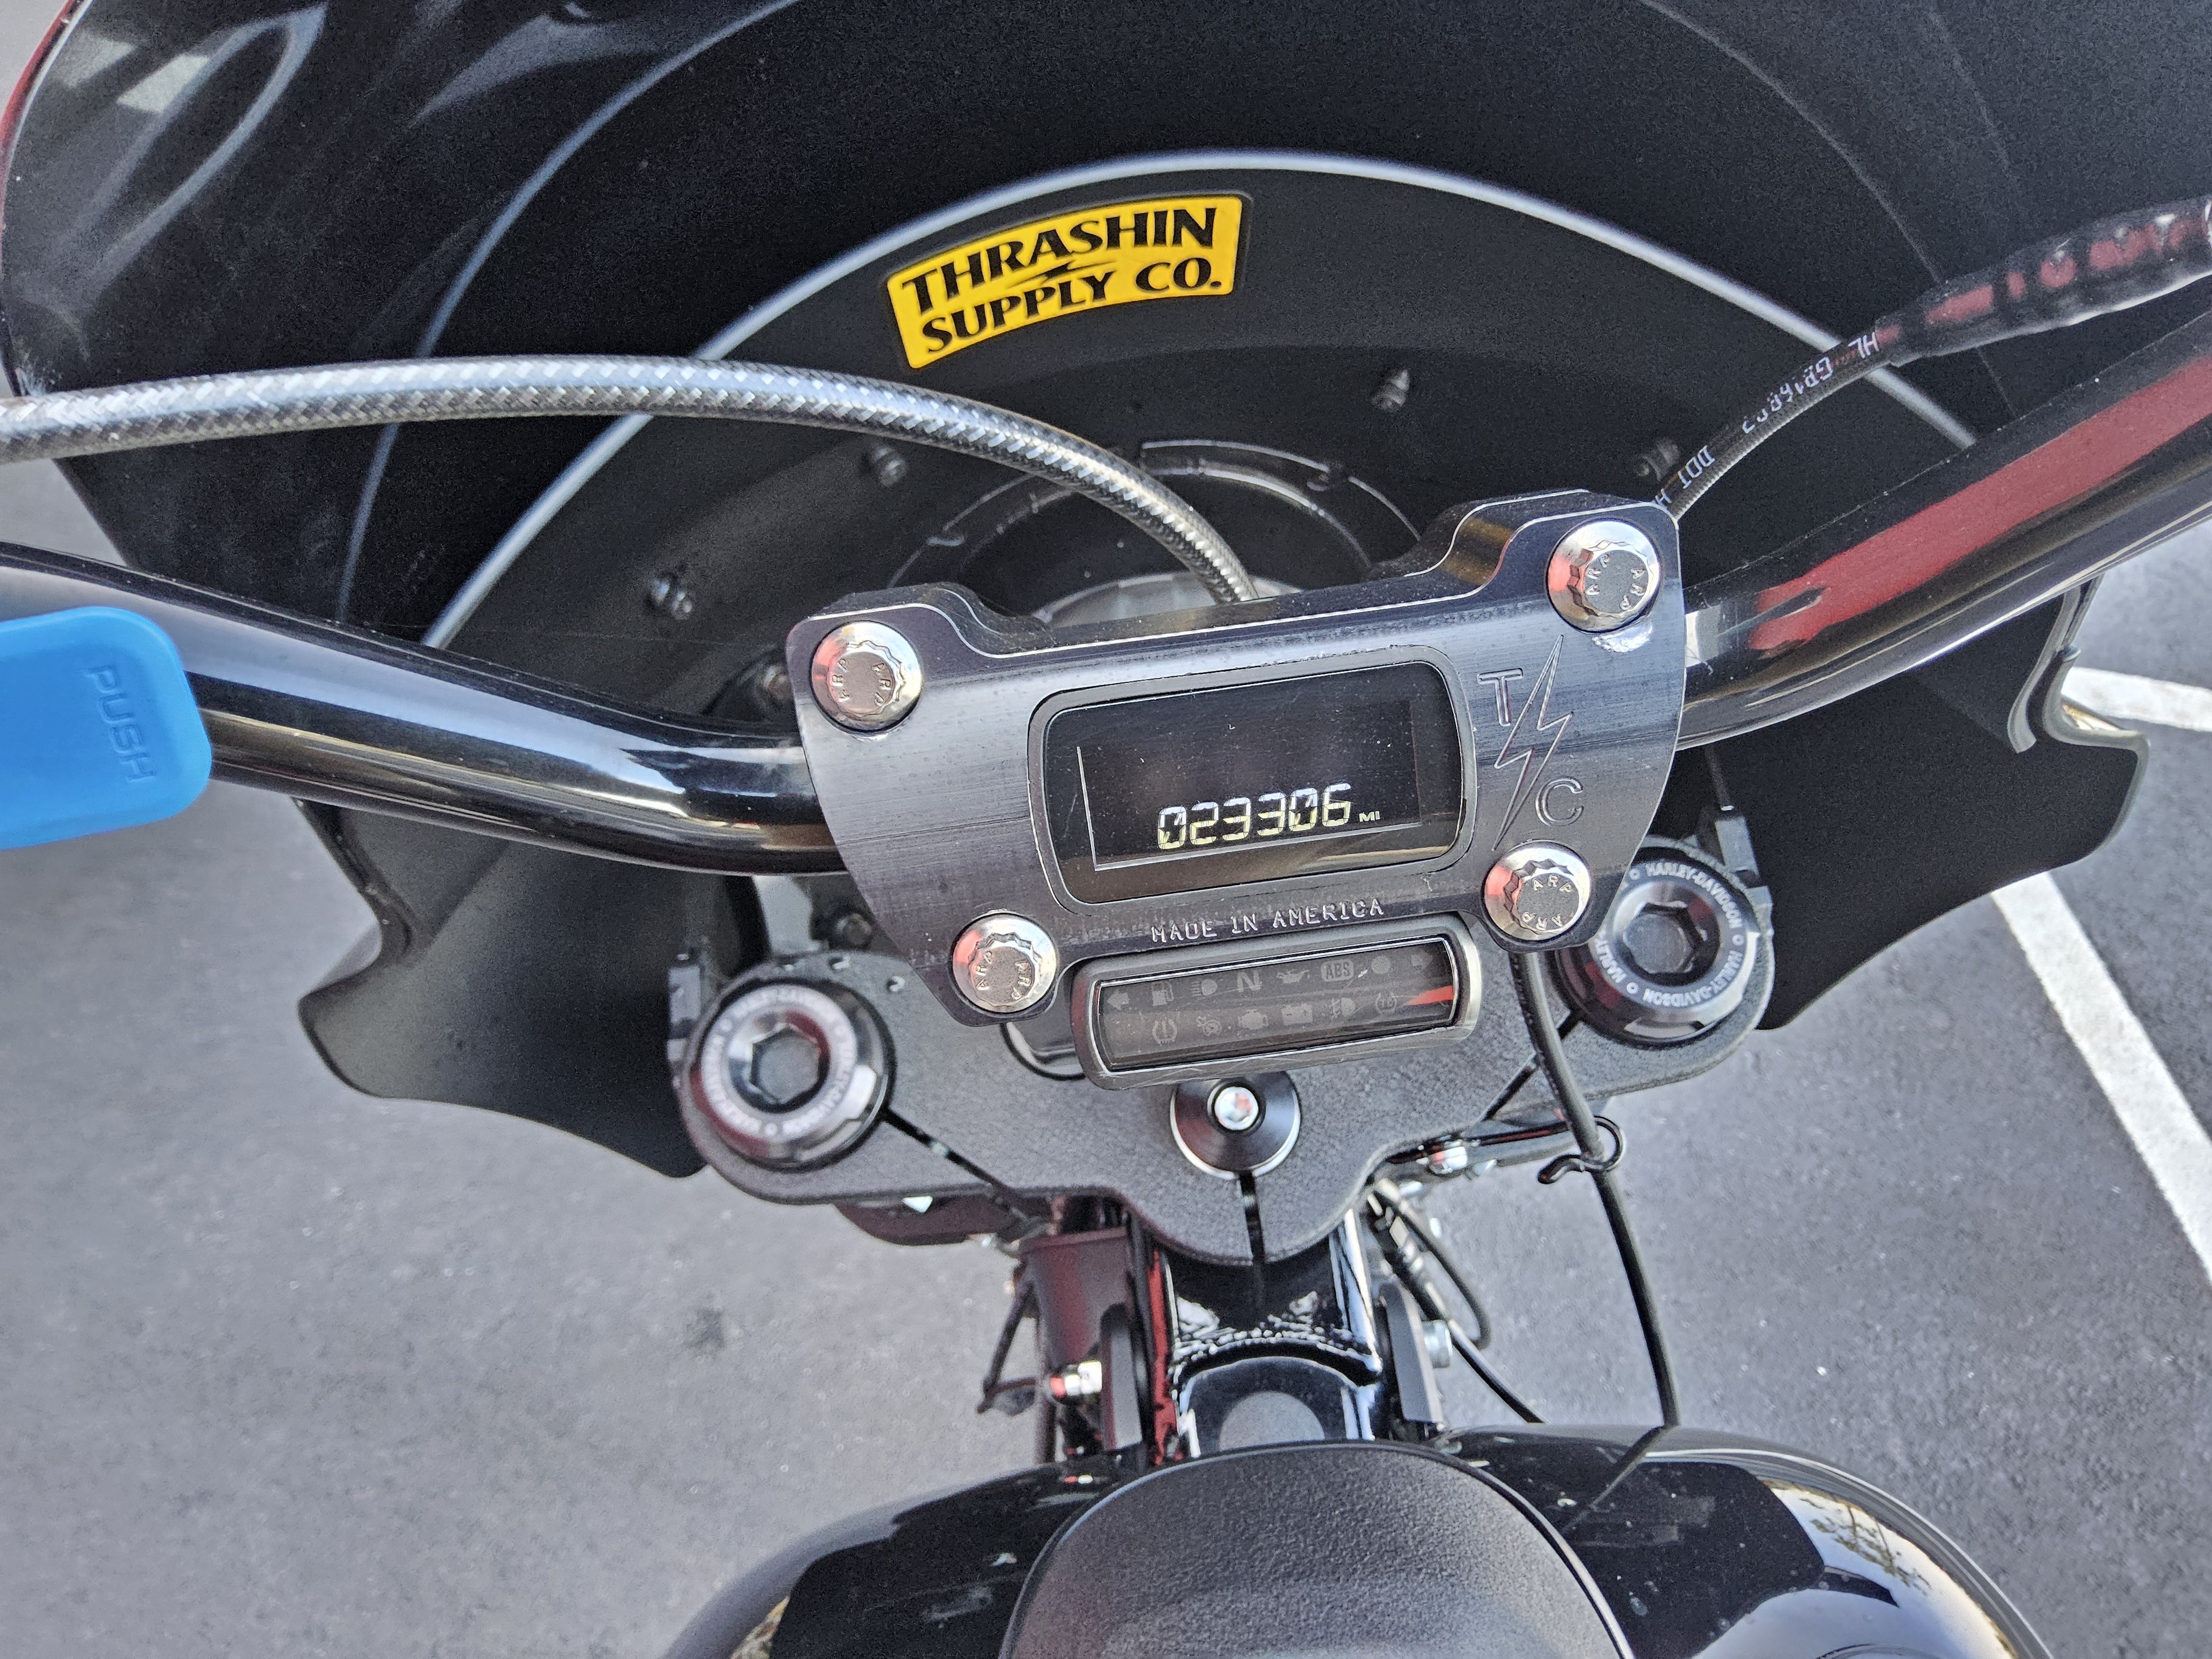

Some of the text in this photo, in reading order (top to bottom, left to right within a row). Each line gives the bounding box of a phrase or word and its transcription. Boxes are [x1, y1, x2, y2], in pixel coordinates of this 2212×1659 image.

[902, 207, 1217, 316] THRASHIN
[921, 257, 1221, 354] SUPPLY CO.
[1677, 445, 1715, 489] DOT
[84, 665, 156, 782] PUSH
[1477, 668, 1523, 727] T
[1157, 783, 1380, 849] 023306 MI
[1536, 777, 1584, 826] C
[1150, 898, 1384, 943] MADE IN AMERICA
[1237, 969, 1261, 992] N
[1325, 960, 1350, 980] ABS
